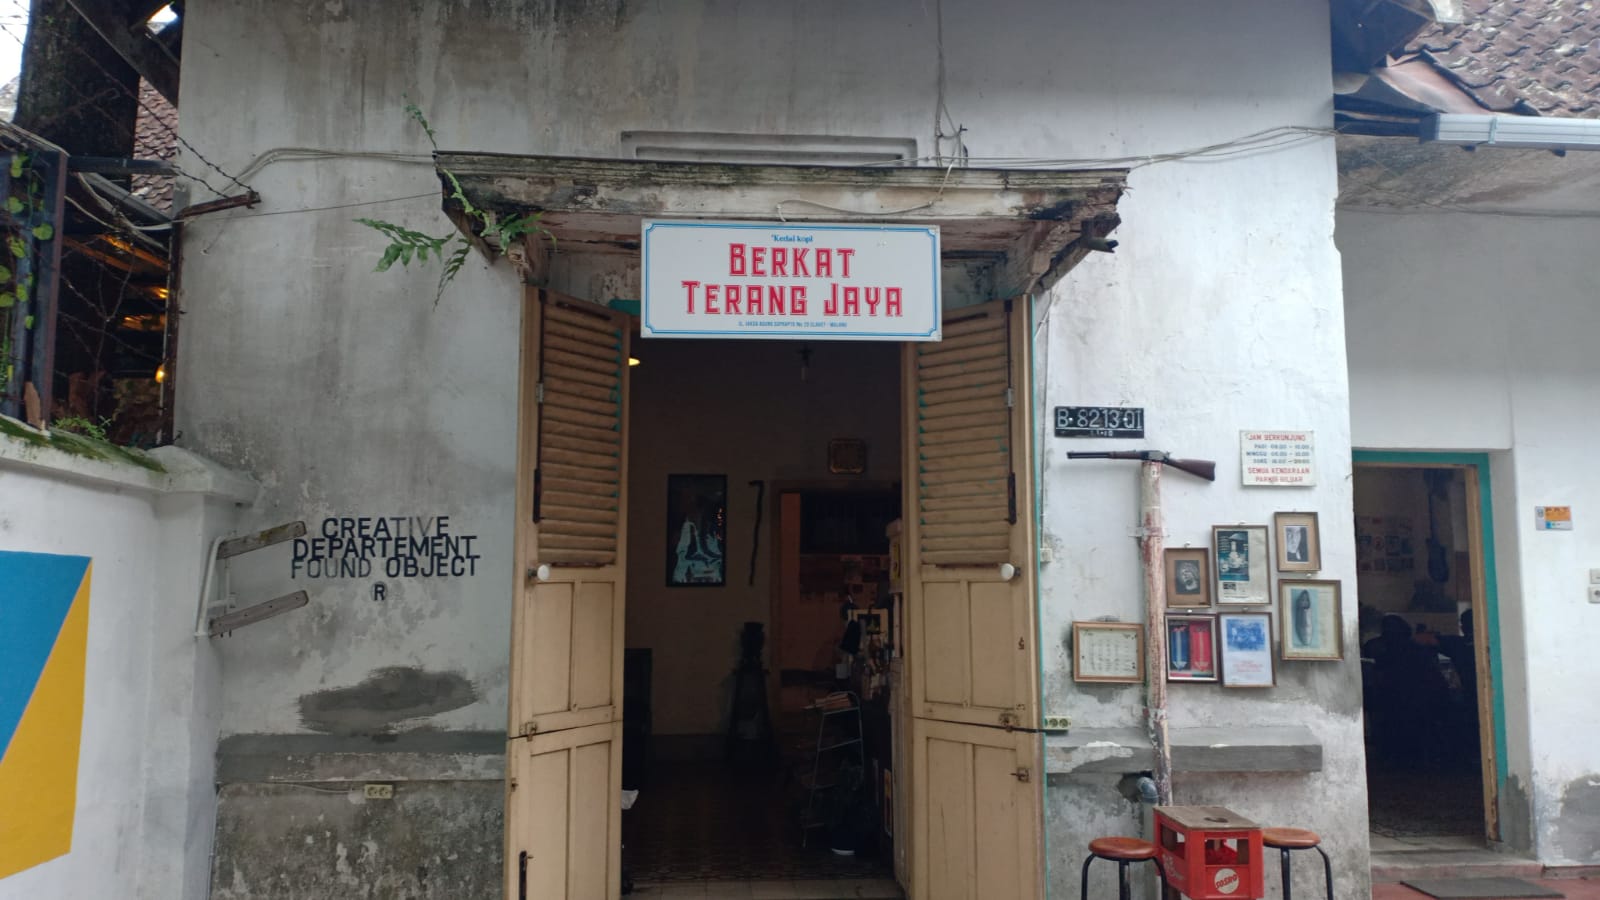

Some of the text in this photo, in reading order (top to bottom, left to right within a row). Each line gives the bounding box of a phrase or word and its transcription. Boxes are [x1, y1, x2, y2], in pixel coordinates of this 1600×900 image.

[729, 243, 856, 278] BERKAT
[681, 280, 903, 317] TERANG JAYA
[1057, 408, 1069, 428] B
[1077, 409, 1120, 429] 8213
[322, 516, 449, 539] CREATIVE
[293, 536, 477, 560] DEPARTEMENT
[291, 555, 480, 579] FOUND OBJECT
